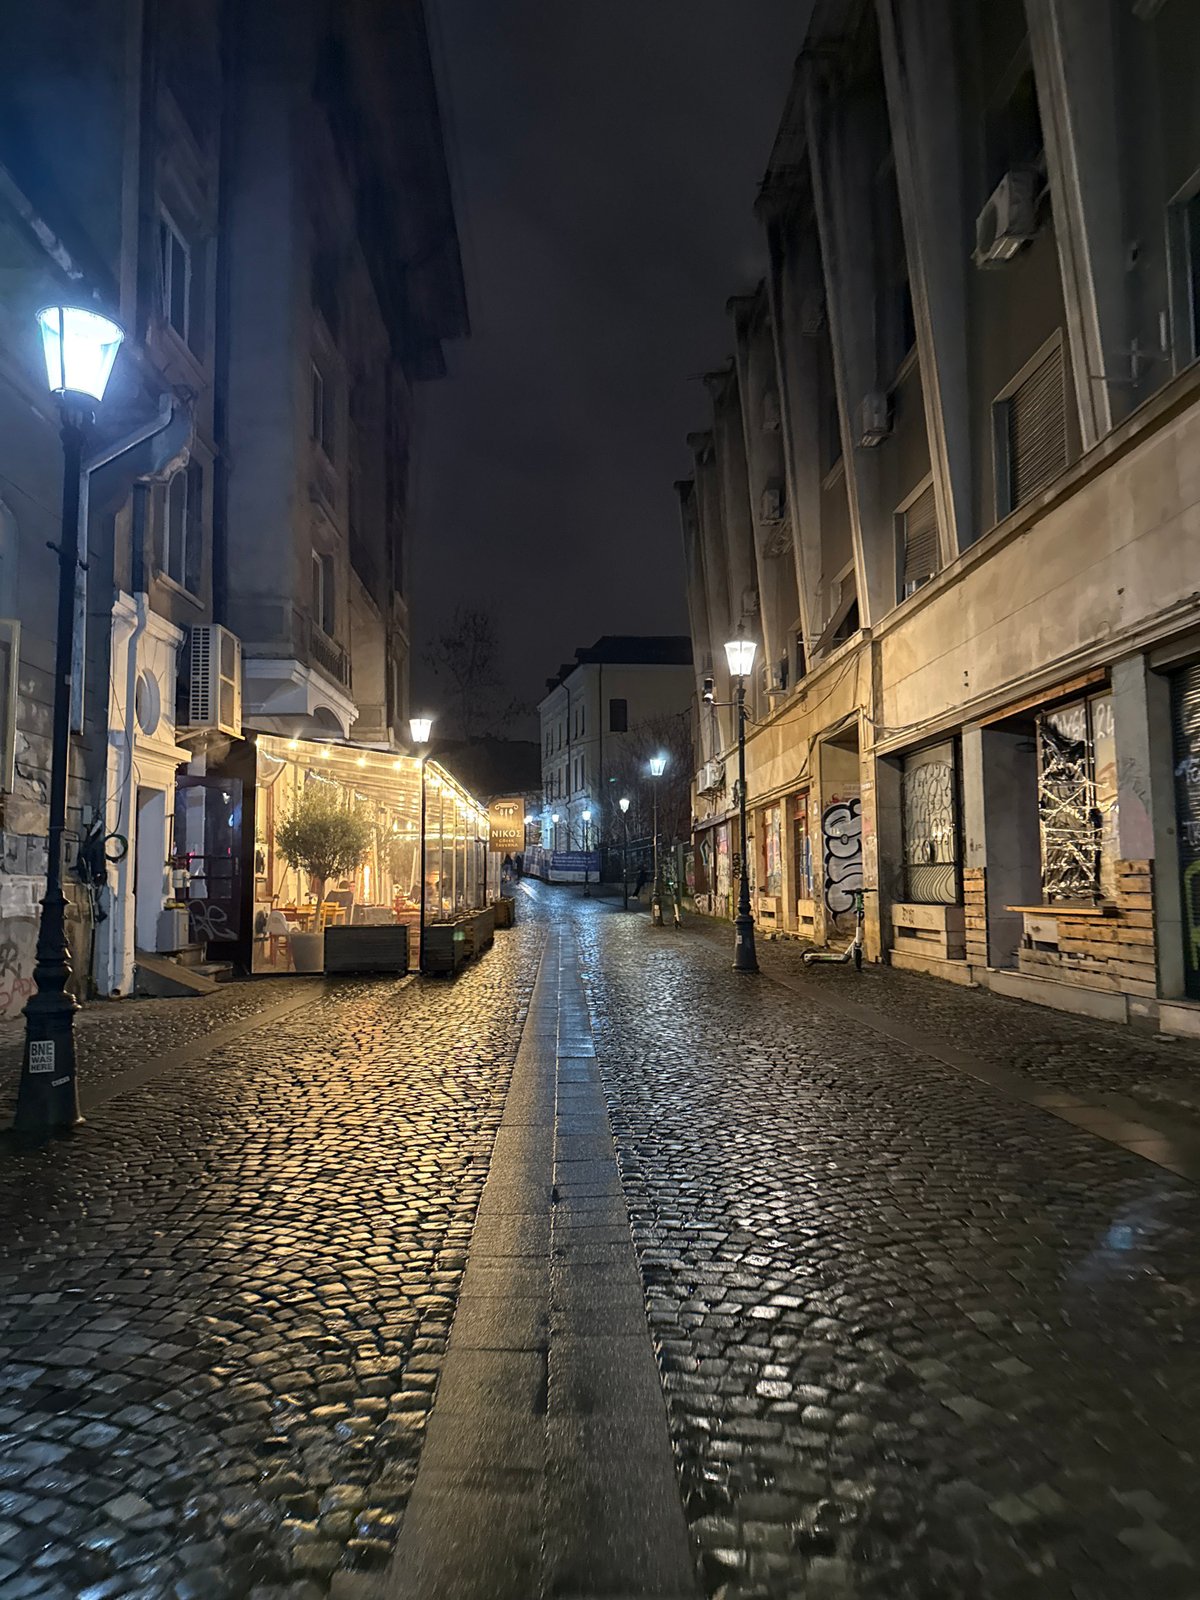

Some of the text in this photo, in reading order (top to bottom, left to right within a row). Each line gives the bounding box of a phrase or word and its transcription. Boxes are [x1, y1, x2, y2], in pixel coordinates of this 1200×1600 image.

[31, 1043, 54, 1056] BNE
[31, 1056, 54, 1064] WAS
[31, 1063, 54, 1071] HERE
